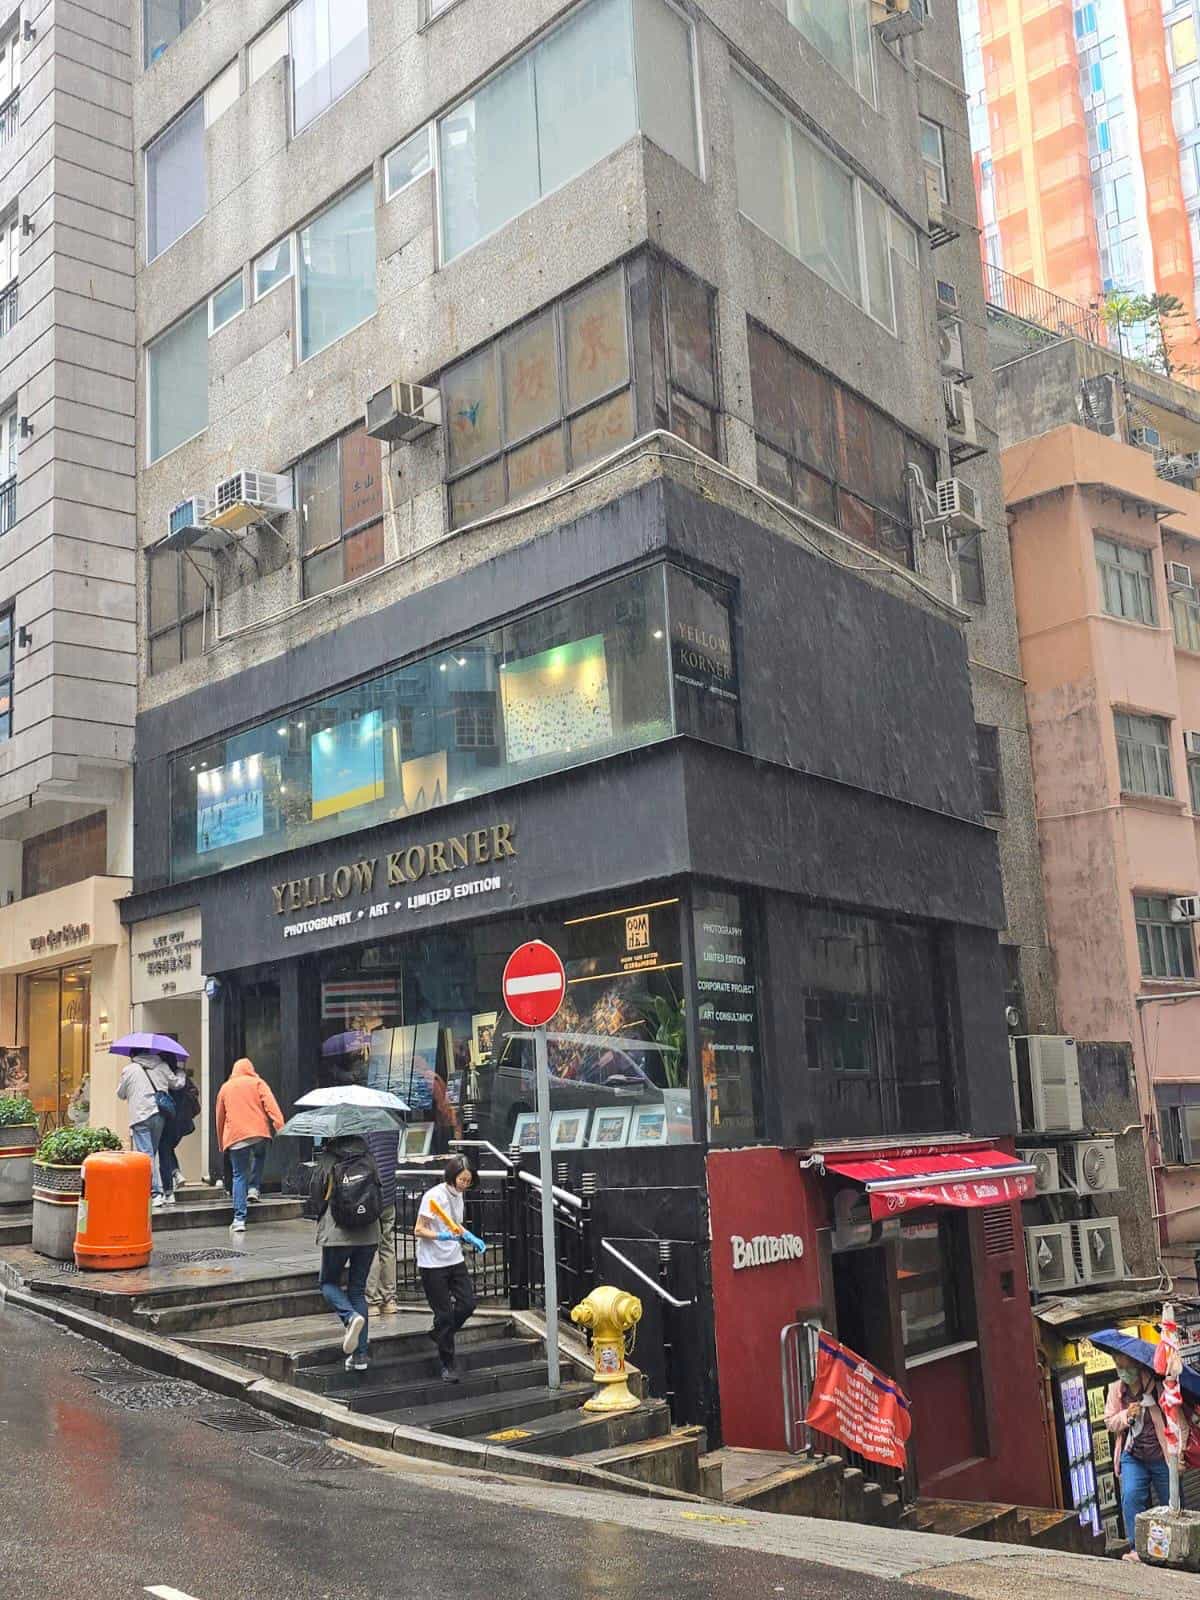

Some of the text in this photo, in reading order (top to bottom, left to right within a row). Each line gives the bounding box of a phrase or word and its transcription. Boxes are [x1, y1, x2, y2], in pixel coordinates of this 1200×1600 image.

[678, 621, 731, 656] YELLOW
[681, 649, 731, 680] KORNER
[272, 823, 518, 915] YELLOW KORNER
[283, 877, 501, 938] PHOTOGRAPHY ART LIMITED EDITION
[703, 923, 743, 936] PHOTOGRAPHY
[704, 951, 745, 965] LIMITED EDITION
[698, 980, 755, 994] CORPORATE PROJECT
[703, 1010, 753, 1022] ART CONSULTANCY
